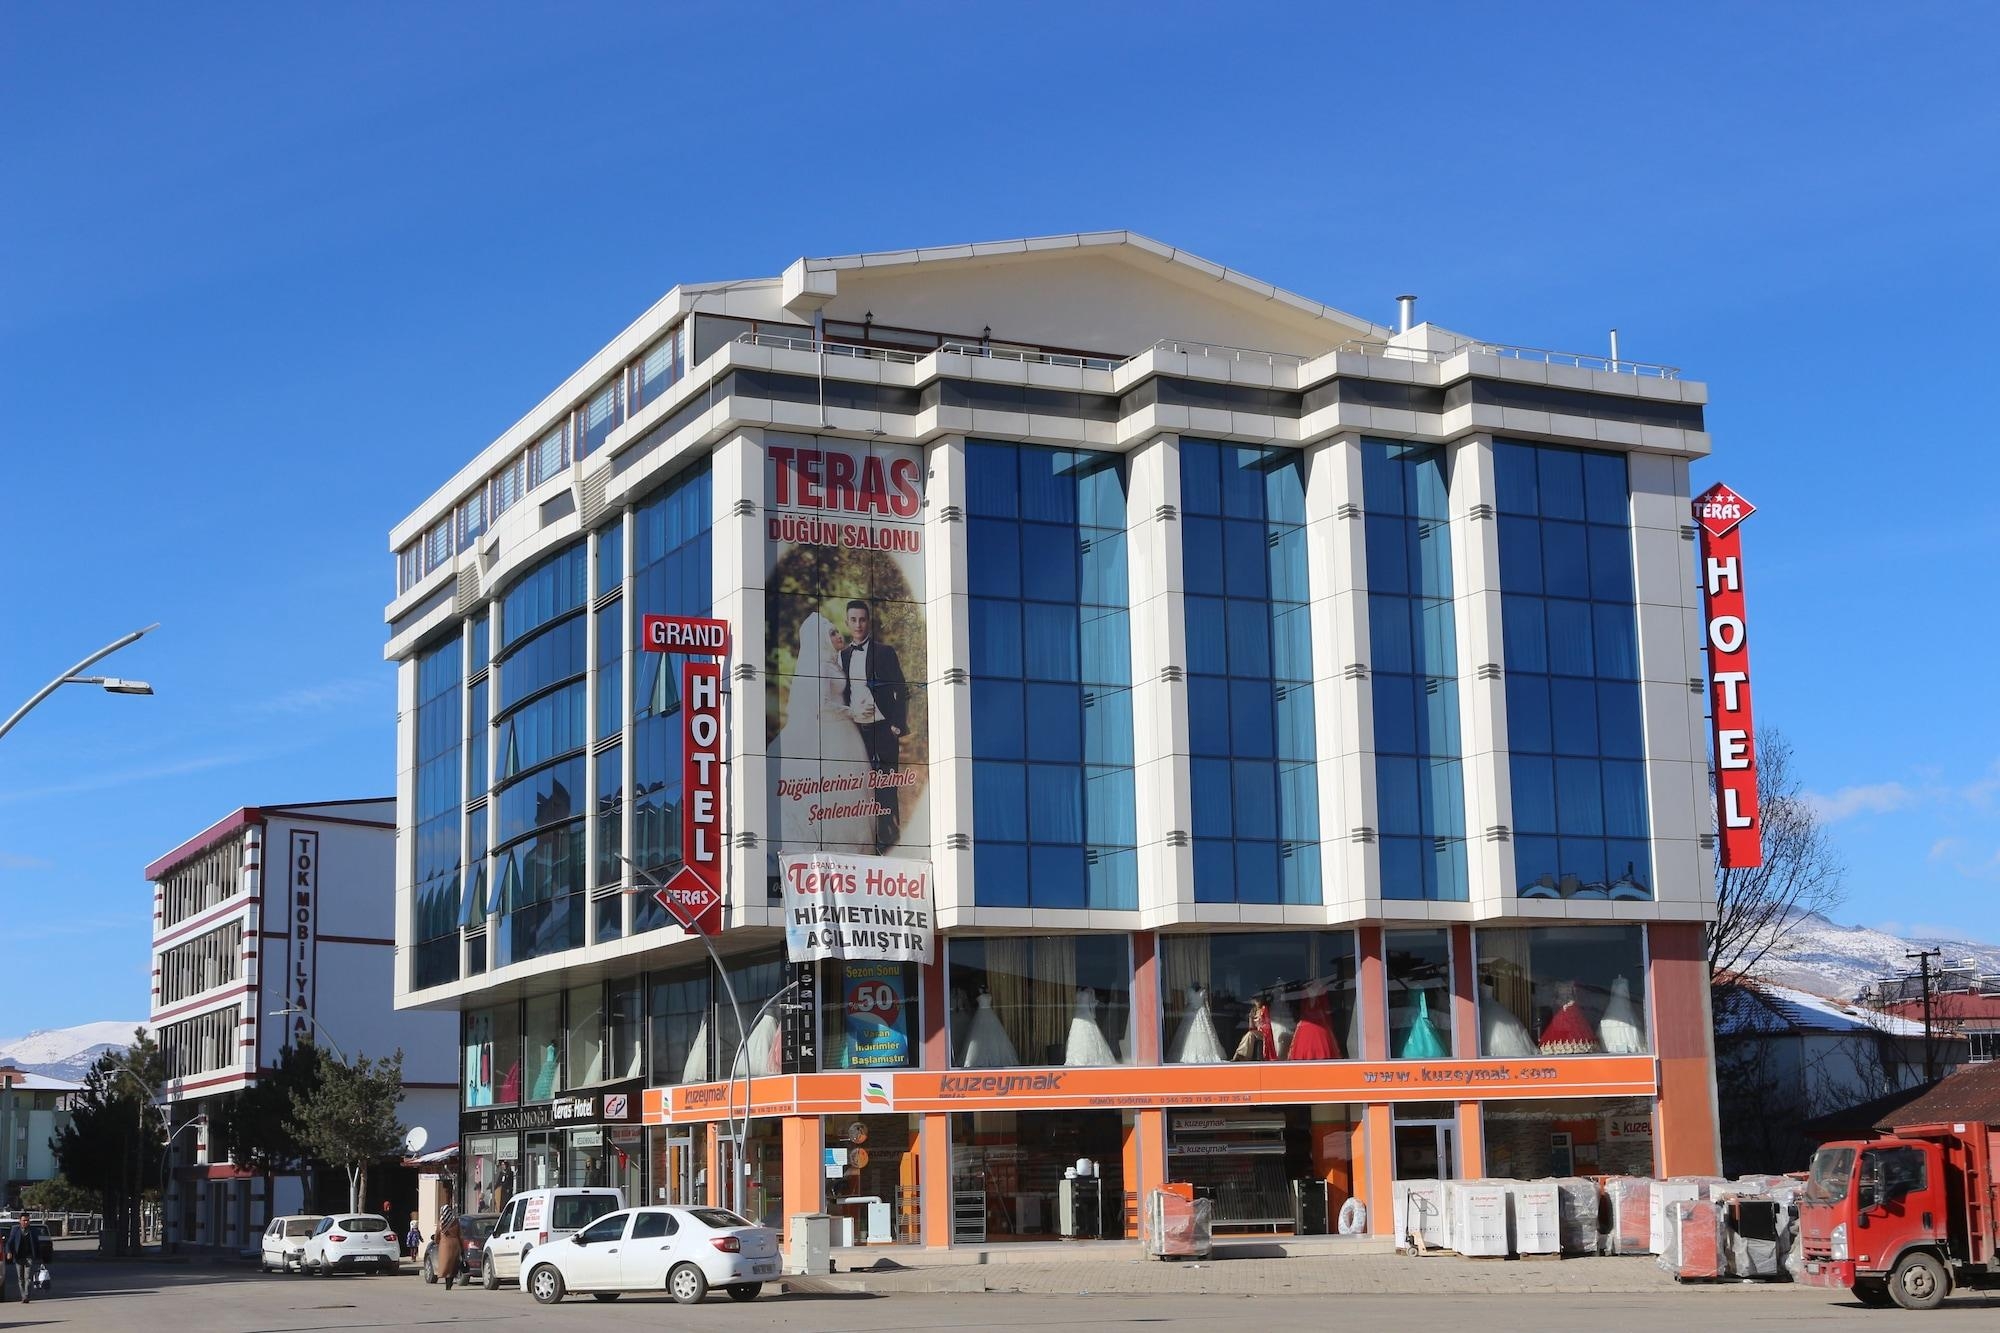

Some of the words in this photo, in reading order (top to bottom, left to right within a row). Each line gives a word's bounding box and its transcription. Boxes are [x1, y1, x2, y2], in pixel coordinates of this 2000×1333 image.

[768, 446, 921, 519] TERAS
[1693, 502, 1741, 520] TERAS
[768, 515, 839, 546] DÜĞÜN
[843, 523, 921, 554] SALONU
[651, 621, 725, 647] GRAND
[1707, 556, 1752, 828] HOTEL
[692, 674, 718, 862] HOTEL
[776, 773, 864, 801] Düğünlerinizi
[868, 768, 916, 789] Bizimle
[297, 838, 311, 887] TOK
[810, 862, 835, 871] GRAND
[787, 862, 857, 895] Teras
[865, 868, 926, 900] Hotel
[794, 902, 929, 929] HİZMETİNİZE
[806, 928, 925, 953] AÇILMIŞTIR
[846, 966, 873, 978] Sezon
[876, 965, 900, 977] Sonu
[685, 1085, 727, 1106] kuzeymak
[940, 1072, 1063, 1096] kuzeymak
[573, 1096, 594, 1118] Hotel
[1184, 1119, 1225, 1129] kuzeymak
[1186, 1144, 1229, 1153] kuzeymak
